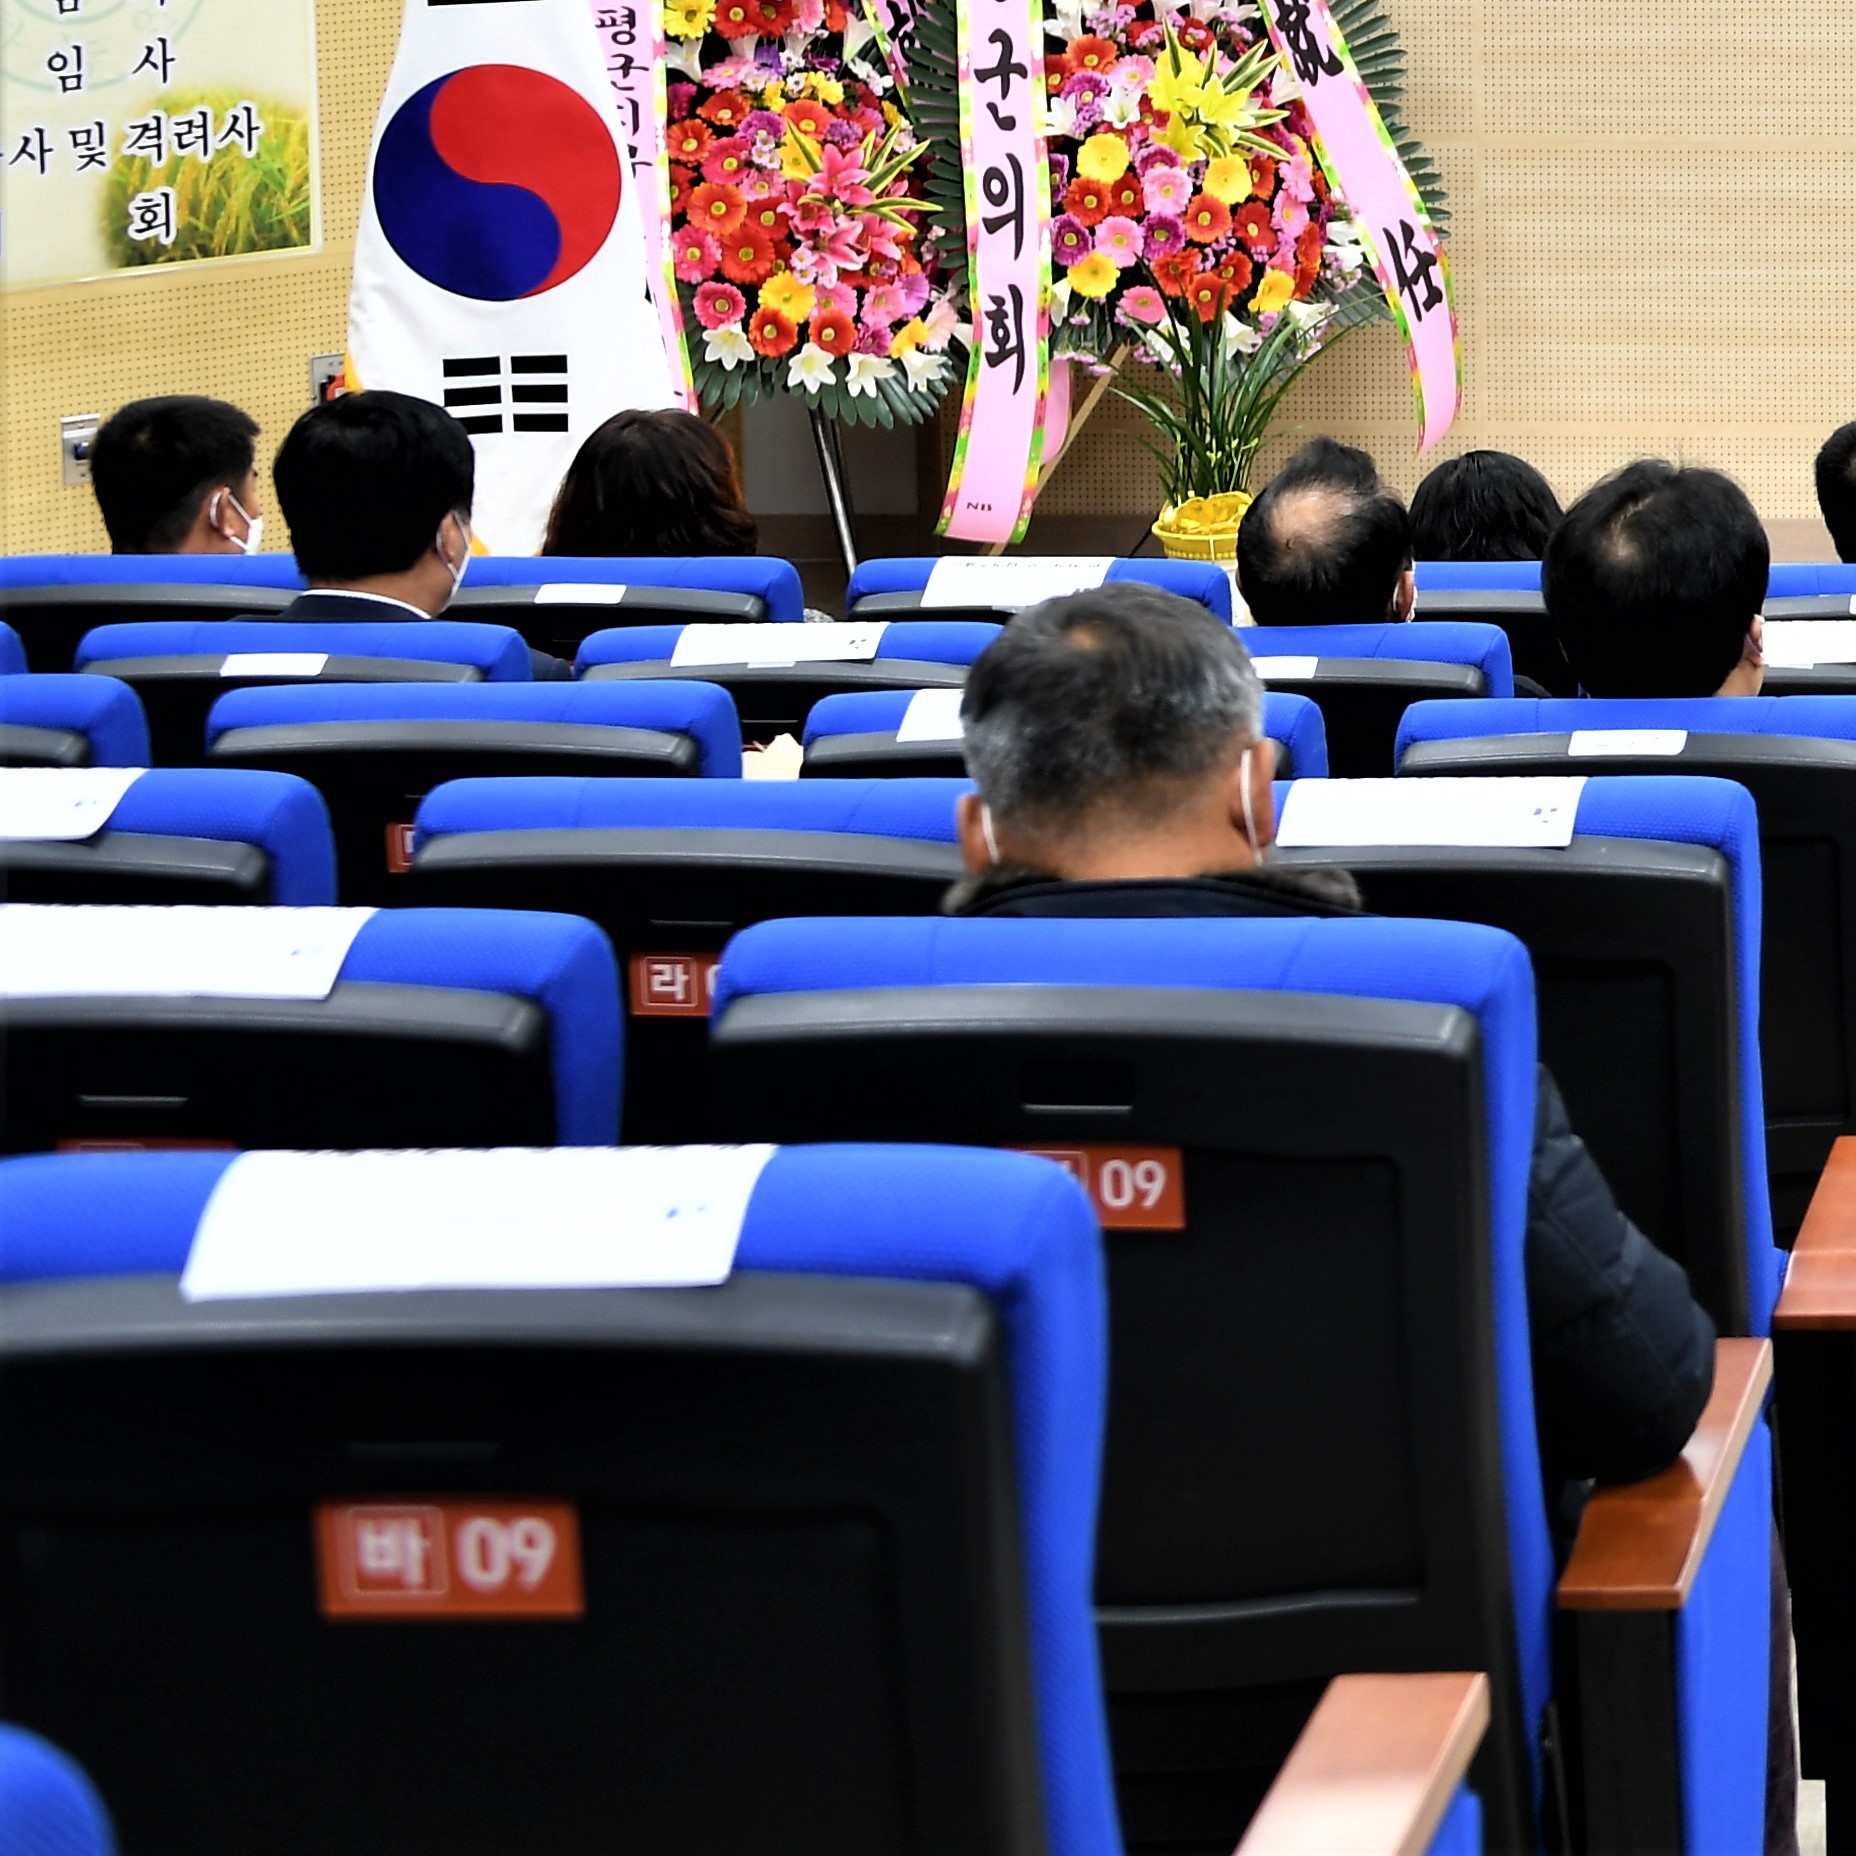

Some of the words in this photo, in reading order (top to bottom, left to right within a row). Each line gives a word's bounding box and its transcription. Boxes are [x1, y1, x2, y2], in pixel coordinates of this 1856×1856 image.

[0, 127, 54, 175] 사
[68, 121, 107, 171] 및
[126, 106, 261, 163] 격려사
[133, 191, 171, 238] 회
[650, 963, 690, 1001] 라
[1101, 1158, 1168, 1210] 09
[456, 1515, 557, 1593] 09
